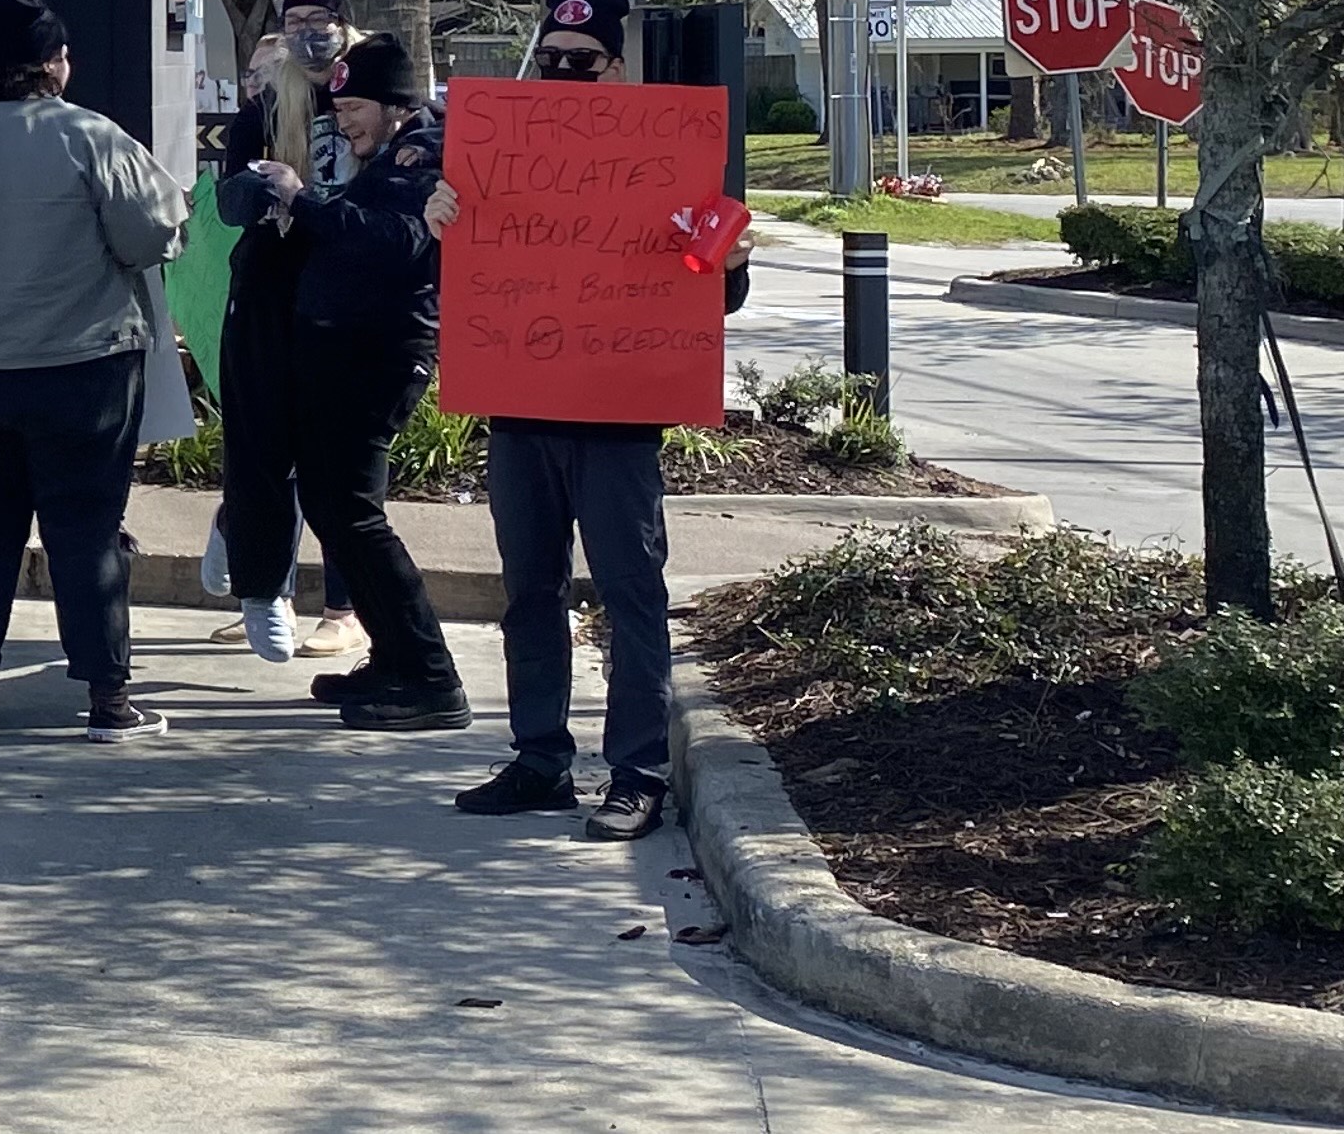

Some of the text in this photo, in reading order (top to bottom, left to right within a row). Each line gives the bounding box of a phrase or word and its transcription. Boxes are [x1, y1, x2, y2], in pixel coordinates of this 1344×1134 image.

[461, 91, 722, 147] STARBUCKS
[467, 149, 677, 200] VIOLATES
[471, 206, 593, 248] LABOR
[470, 271, 560, 307] Support
